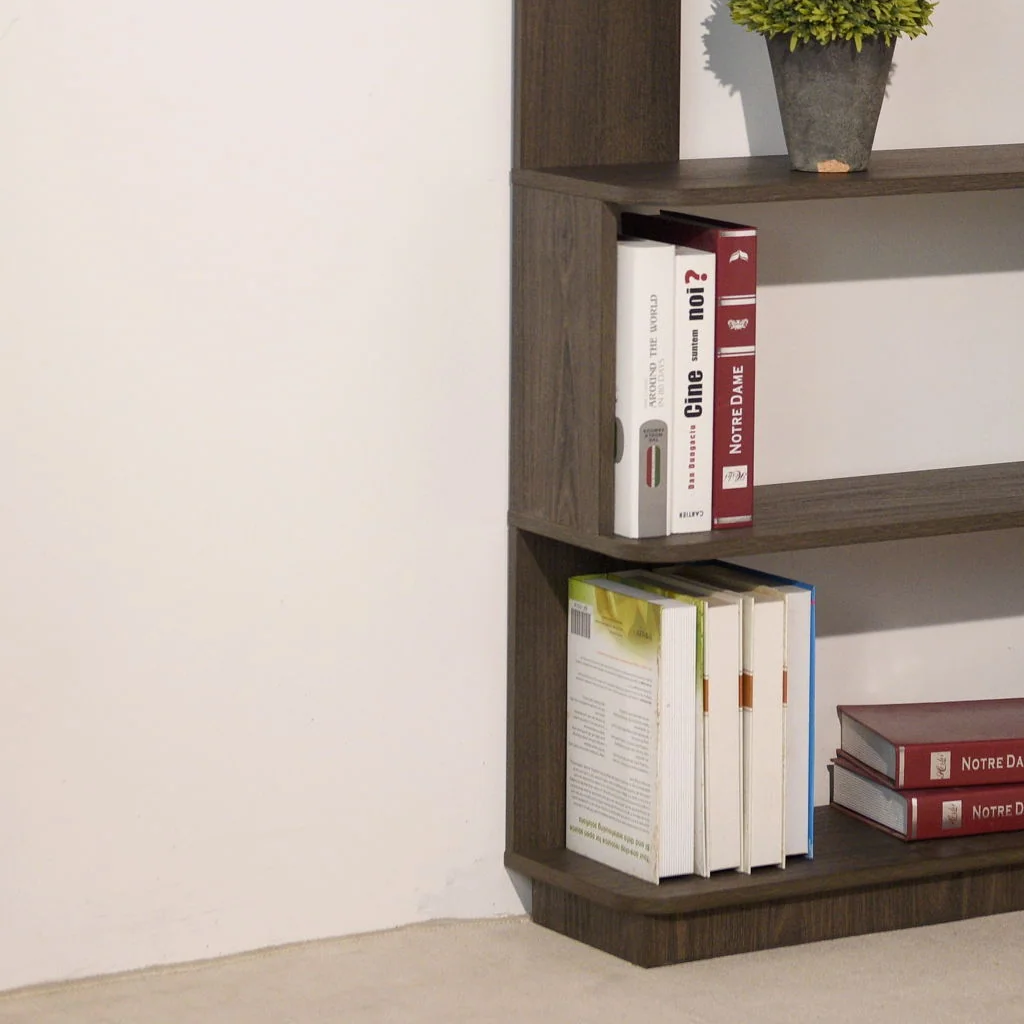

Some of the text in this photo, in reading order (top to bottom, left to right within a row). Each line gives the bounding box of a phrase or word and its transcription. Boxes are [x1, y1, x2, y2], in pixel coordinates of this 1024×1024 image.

[648, 294, 658, 408] AROUND THE WORLD
[684, 269, 708, 418] Cine suntem noi?
[729, 365, 745, 405] DAME
[729, 407, 744, 455] NOTRE
[961, 755, 1004, 772] NOTRE
[972, 803, 1013, 818] NOTRE
